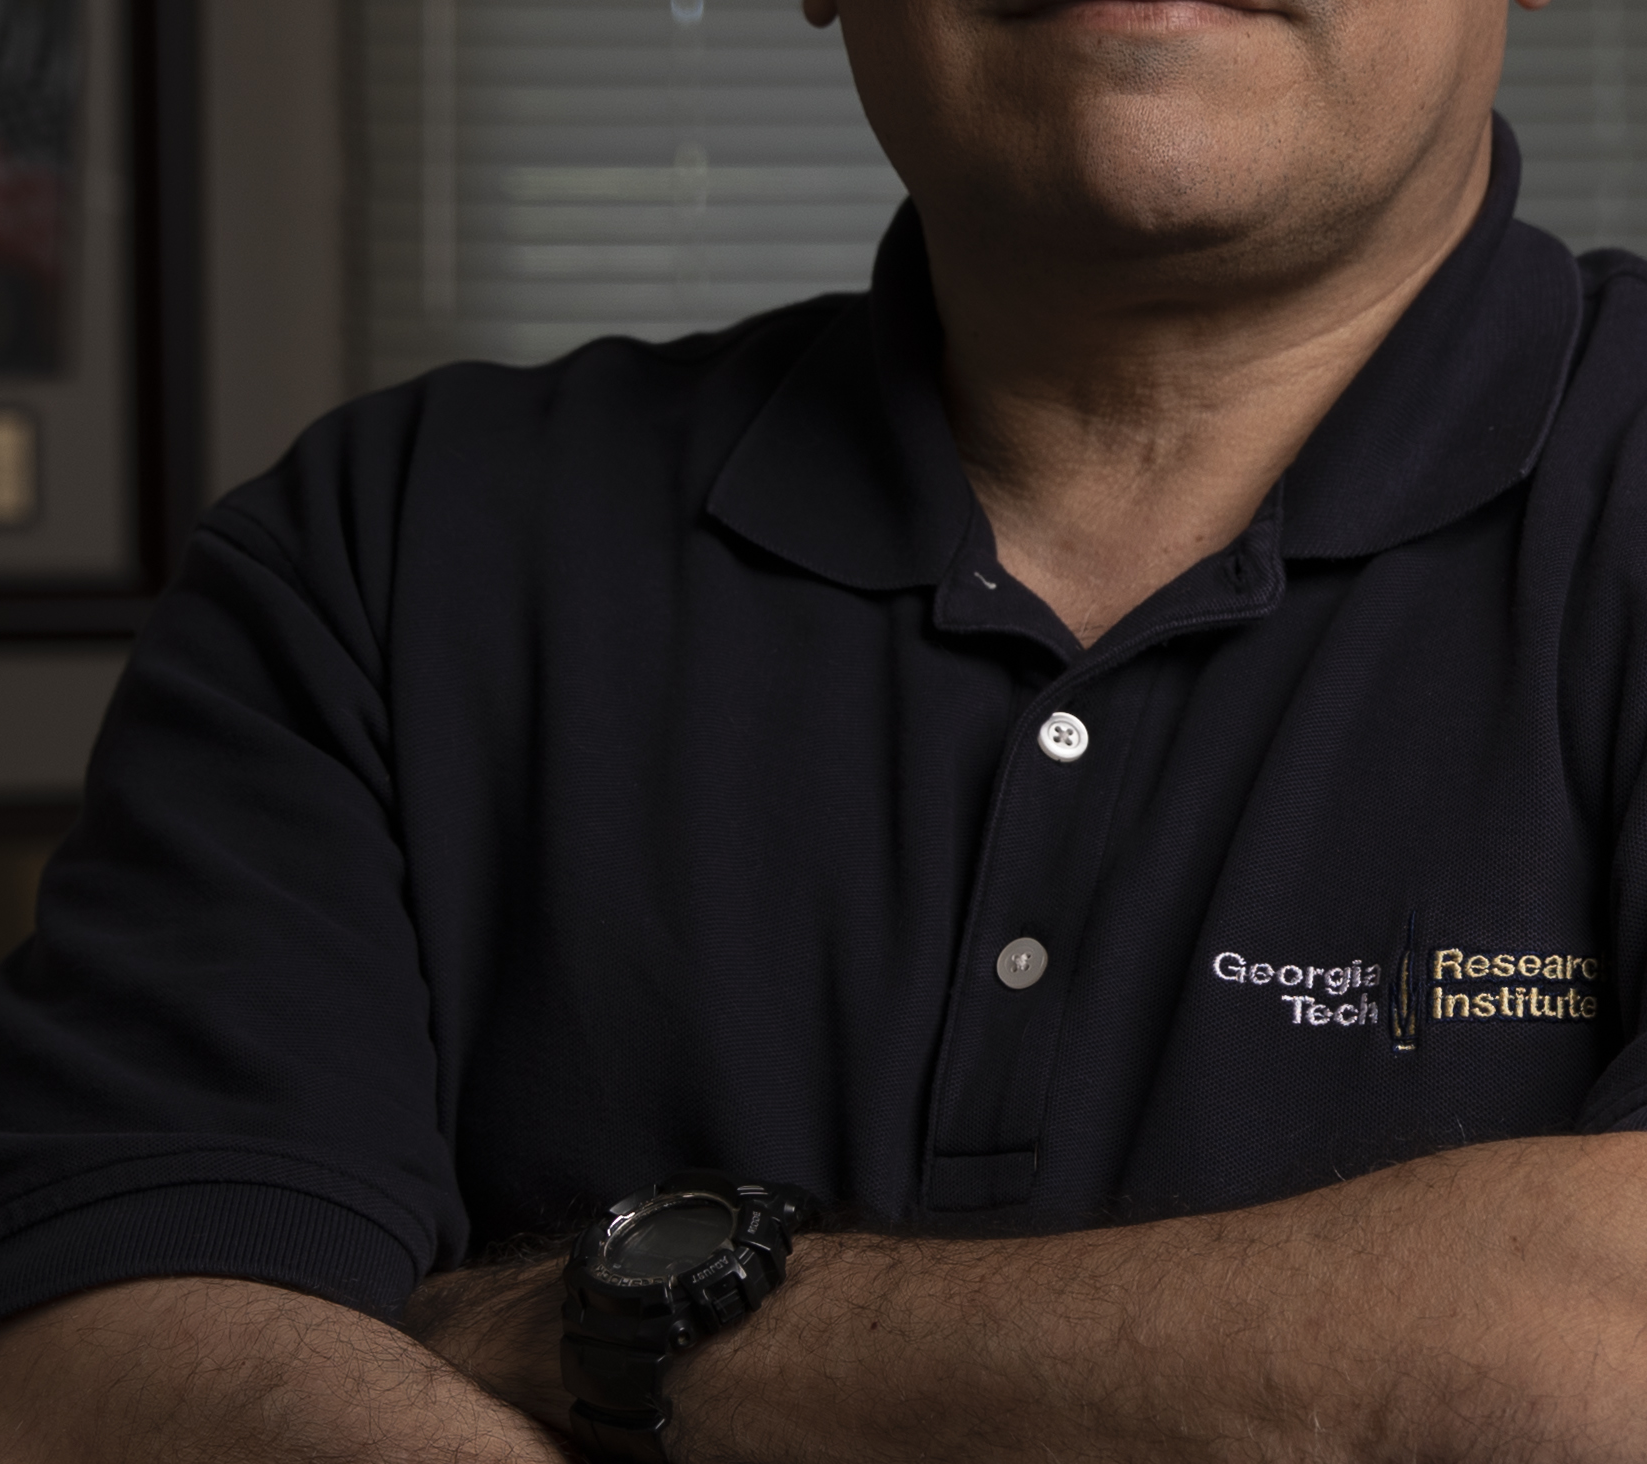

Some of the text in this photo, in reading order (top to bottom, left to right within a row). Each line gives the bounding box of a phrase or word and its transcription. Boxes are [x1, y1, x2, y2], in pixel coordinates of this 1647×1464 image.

[1211, 949, 1382, 997] Georgia
[1281, 990, 1380, 1027] Tech
[1430, 985, 1600, 1023] Institute
[690, 1254, 731, 1285] ADJUST
